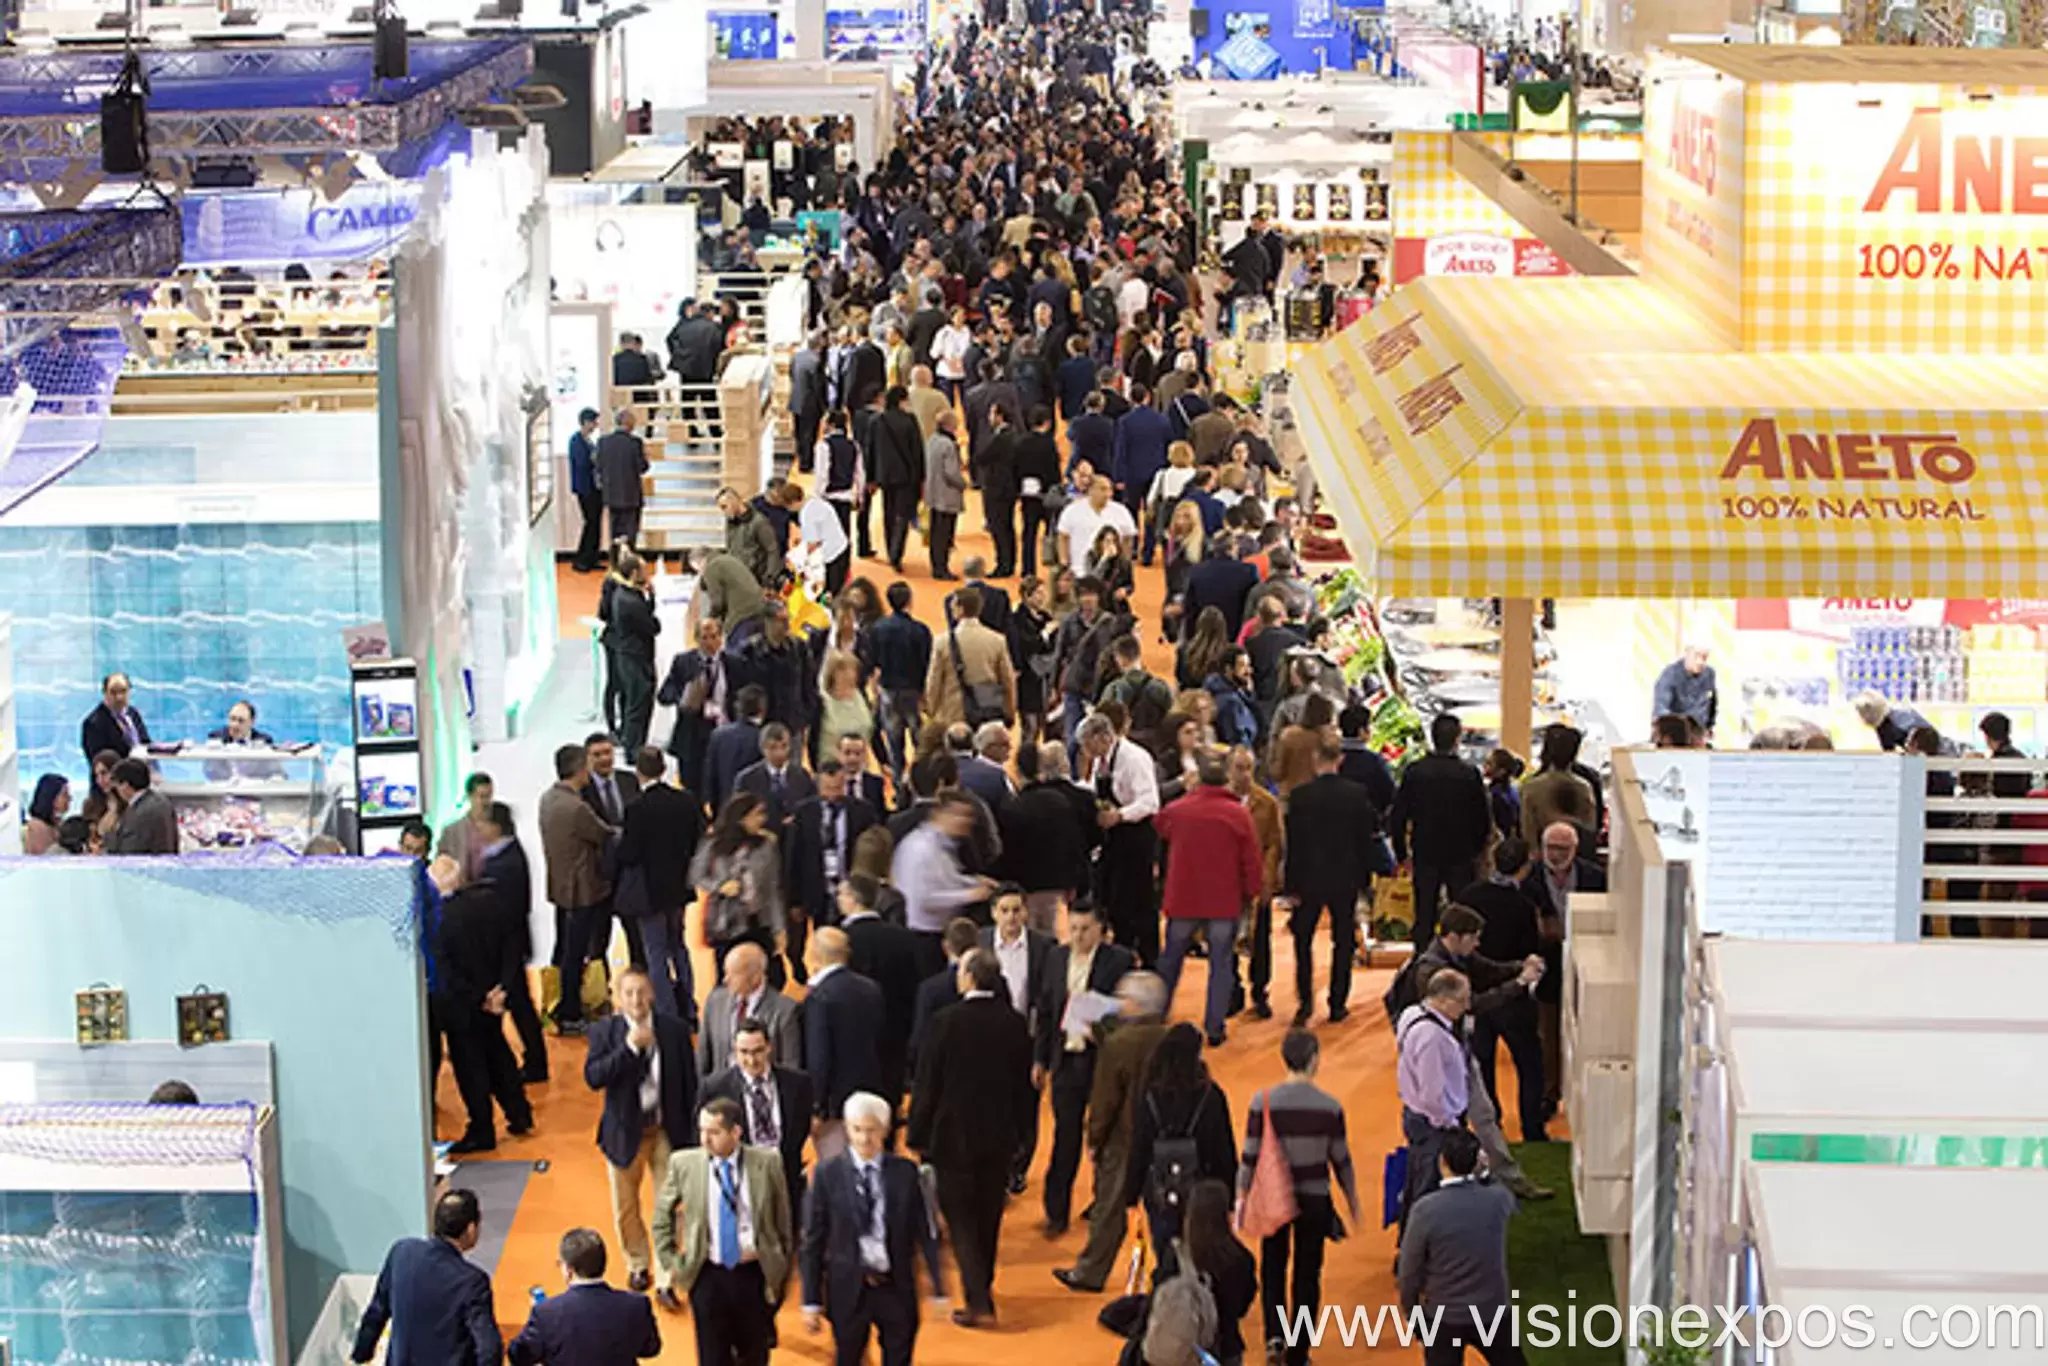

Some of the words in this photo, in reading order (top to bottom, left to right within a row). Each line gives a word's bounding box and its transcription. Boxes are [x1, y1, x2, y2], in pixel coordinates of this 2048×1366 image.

[1859, 242, 1961, 280] 100%
[1720, 418, 1977, 484] ANETO
[1722, 496, 1809, 519] 100%
[1818, 497, 1986, 521] NATURAL
